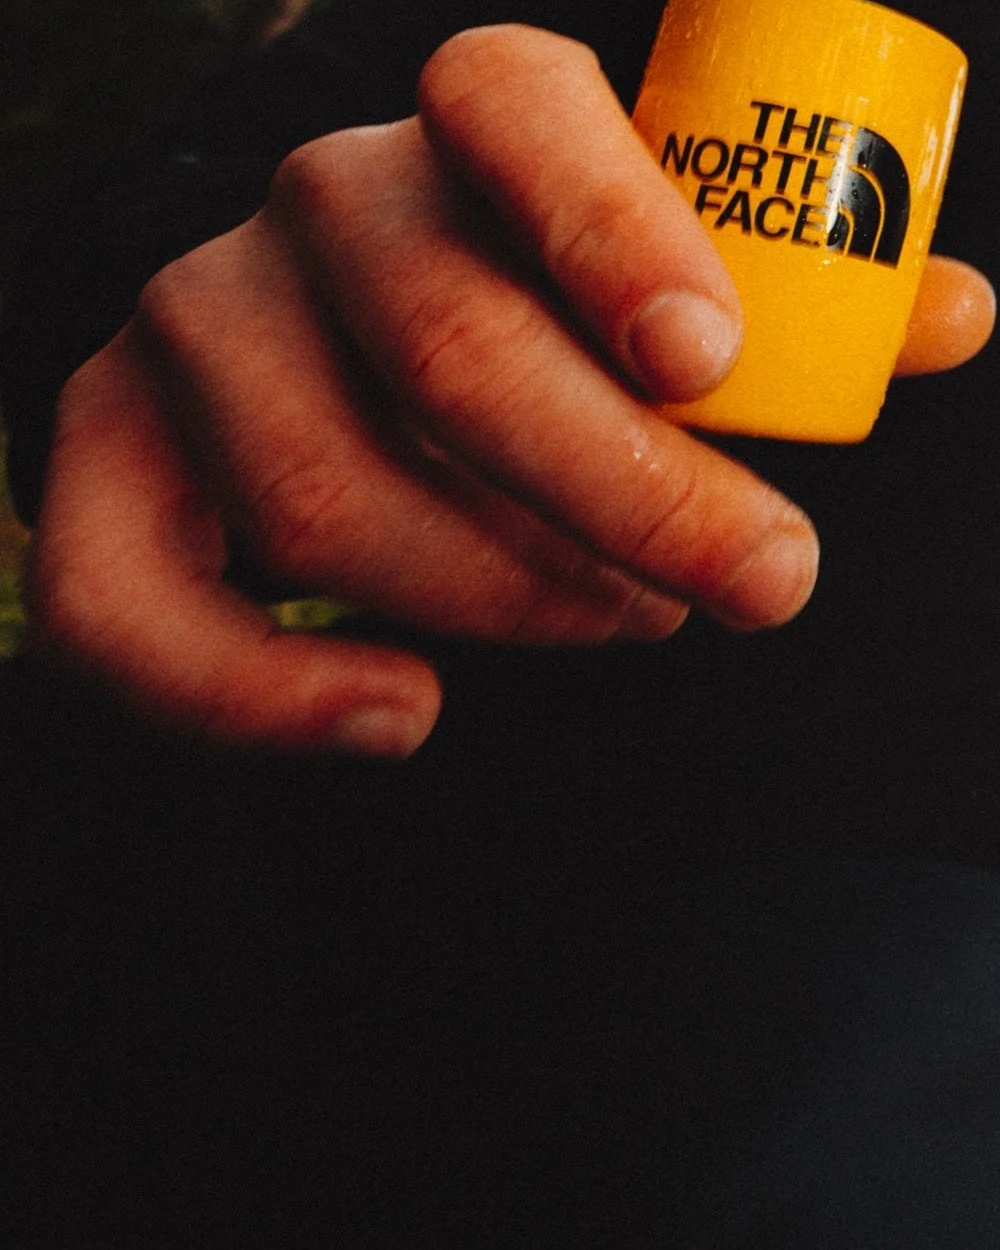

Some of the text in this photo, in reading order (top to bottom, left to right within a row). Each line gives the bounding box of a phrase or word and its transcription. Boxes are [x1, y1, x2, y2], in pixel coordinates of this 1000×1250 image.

[749, 100, 856, 159] THE
[660, 132, 840, 201] NORTH
[694, 183, 830, 249] FACE
